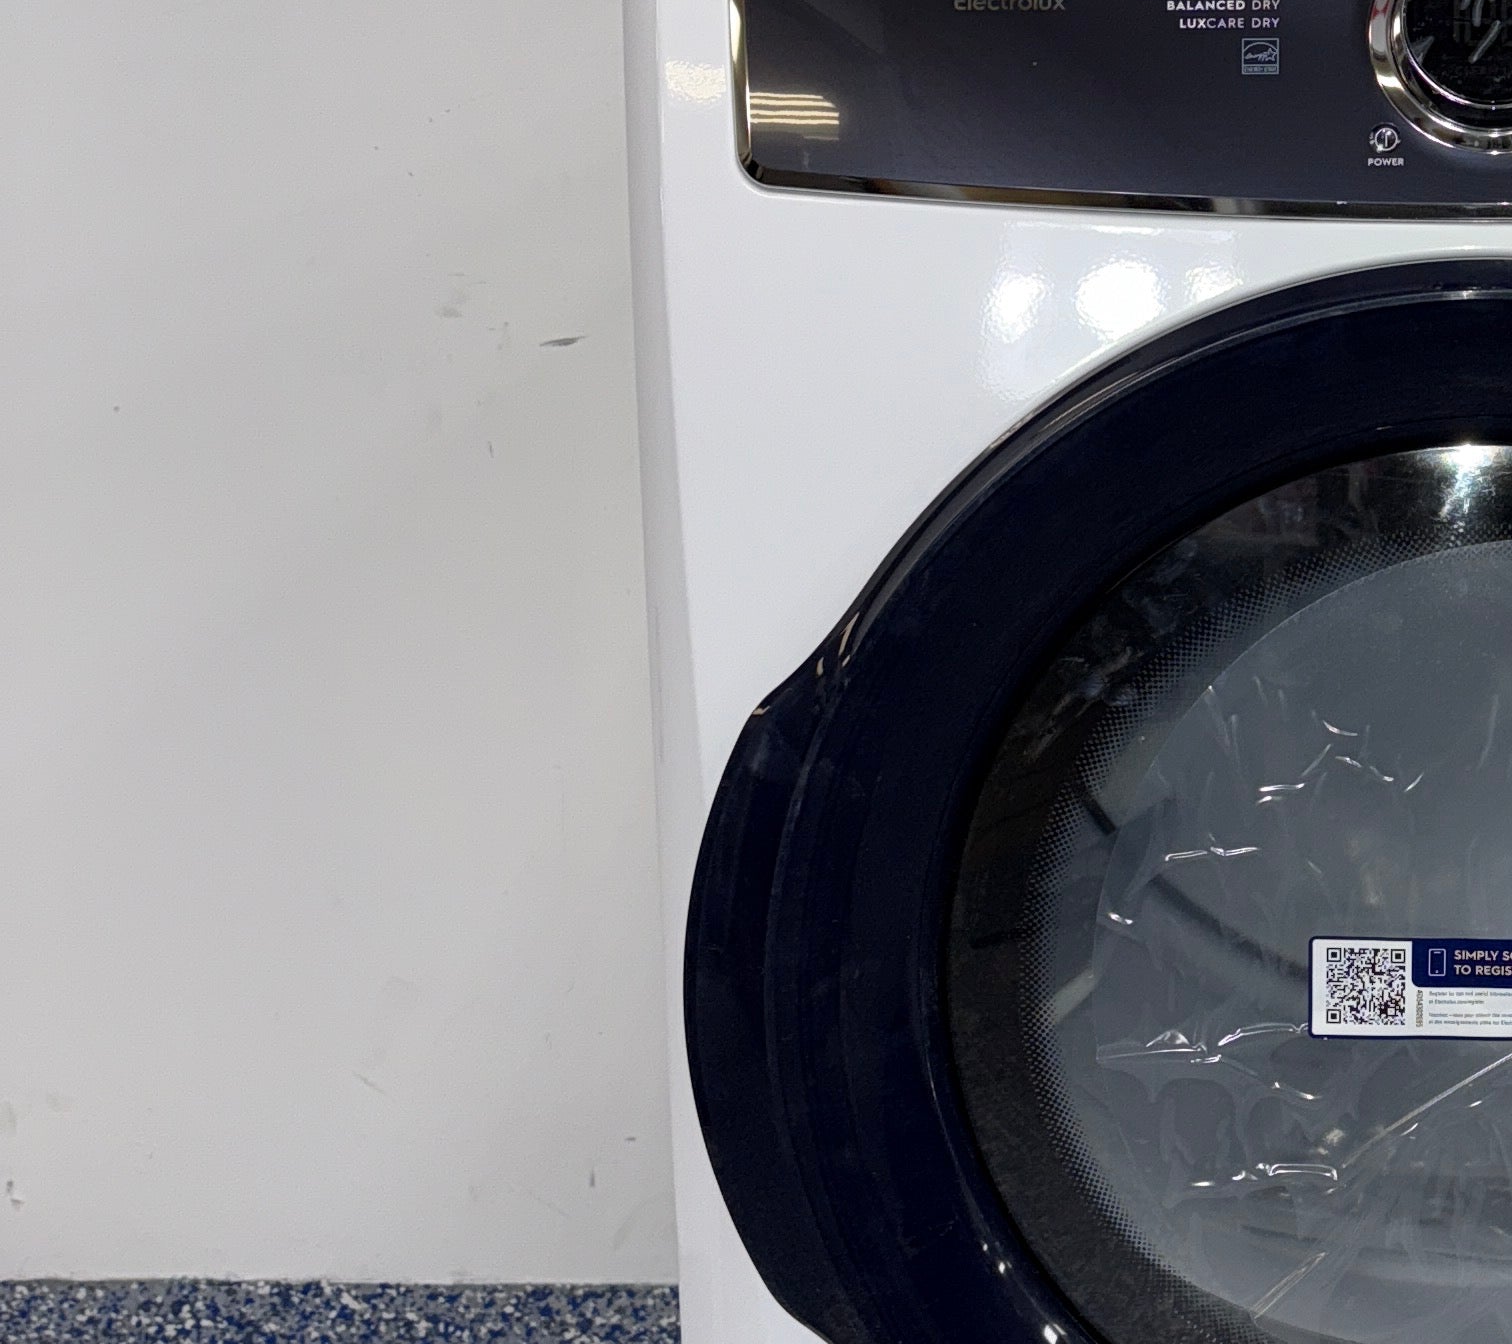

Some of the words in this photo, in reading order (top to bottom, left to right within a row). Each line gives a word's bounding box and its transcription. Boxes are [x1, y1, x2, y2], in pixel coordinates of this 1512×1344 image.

[1167, 0, 1245, 10] BALANCED
[1252, 0, 1280, 10] DRY
[1180, 18, 1244, 28] LUXCARE
[1252, 18, 1279, 28] DRY
[1368, 158, 1404, 166] POWER
[1454, 949, 1500, 961] SIMPLY
[1454, 965, 1471, 976] TO
